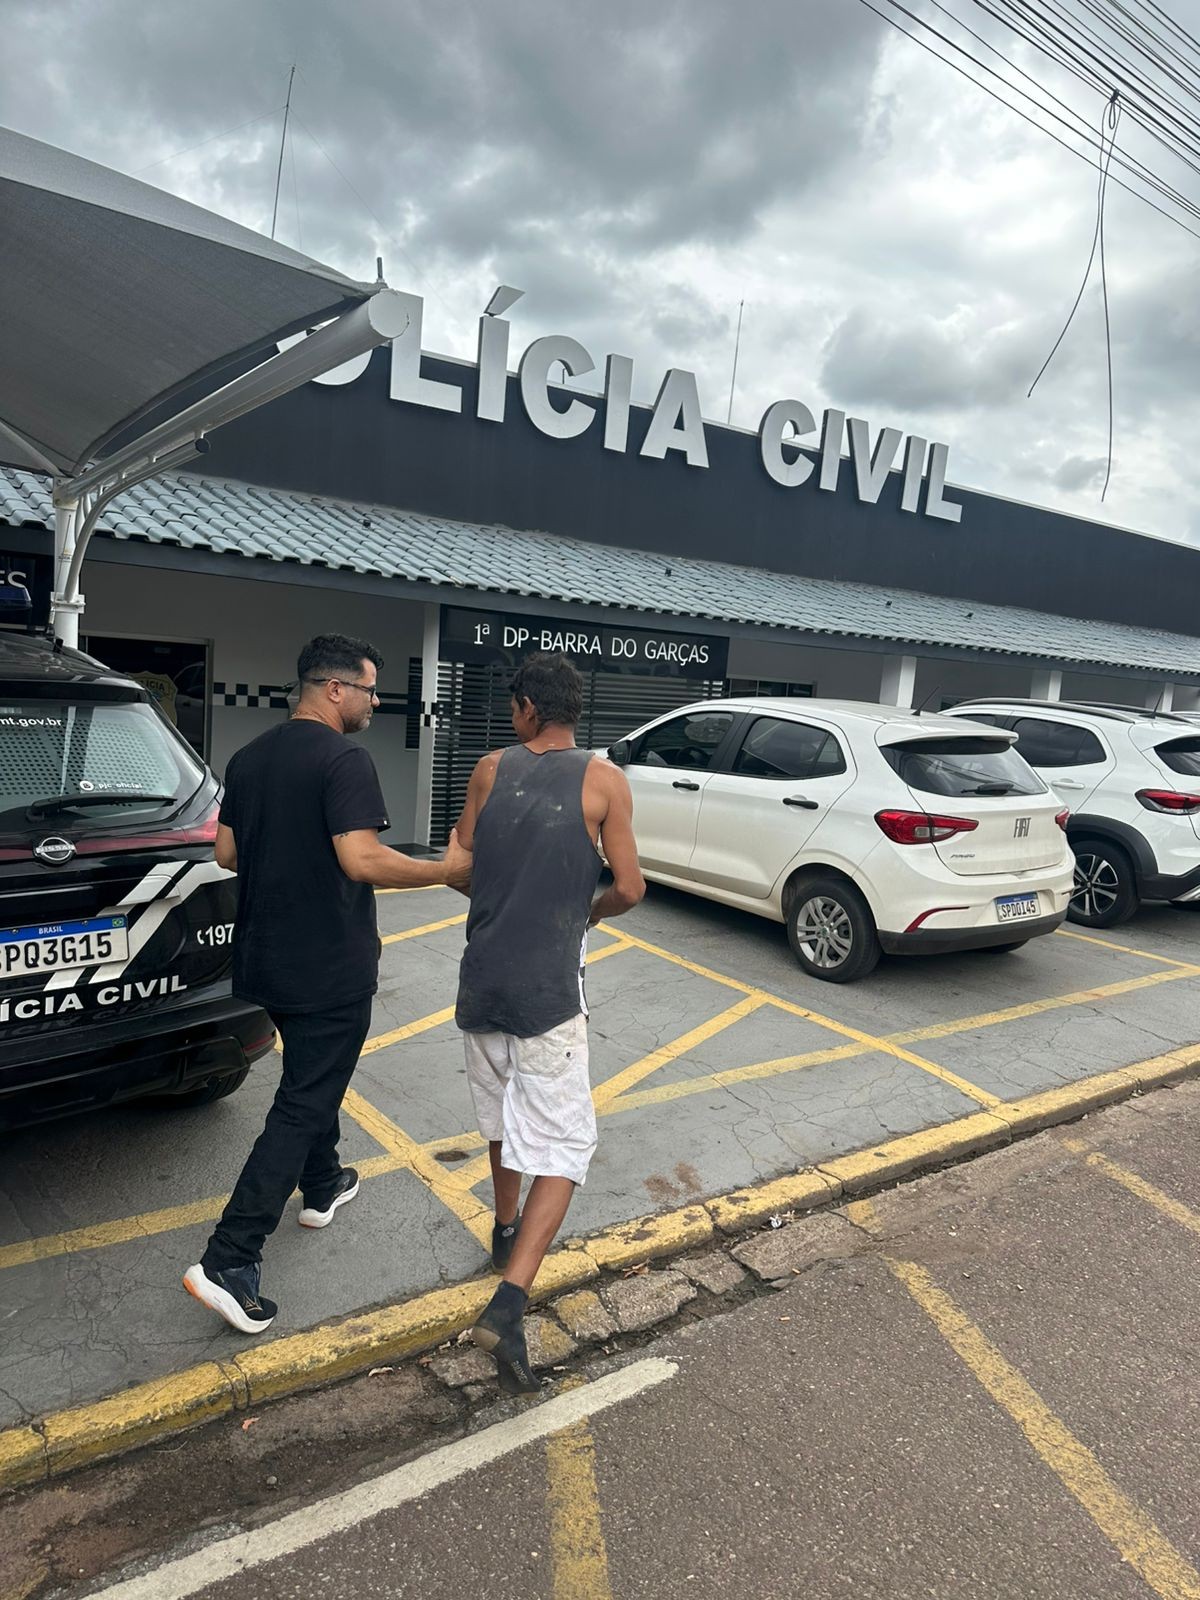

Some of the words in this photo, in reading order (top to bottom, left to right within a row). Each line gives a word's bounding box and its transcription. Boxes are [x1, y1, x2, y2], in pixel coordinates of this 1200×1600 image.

[310, 285, 708, 468] LÍCIA
[760, 399, 963, 523] CIVIL
[474, 623, 490, 645] 1ª
[611, 637, 637, 658] DO
[644, 640, 709, 666] GARÇAS
[1013, 817, 1031, 838] FIAT
[38, 926, 63, 935] BRASIL
[205, 923, 235, 946] 197
[97, 975, 188, 1006] CIVIL
